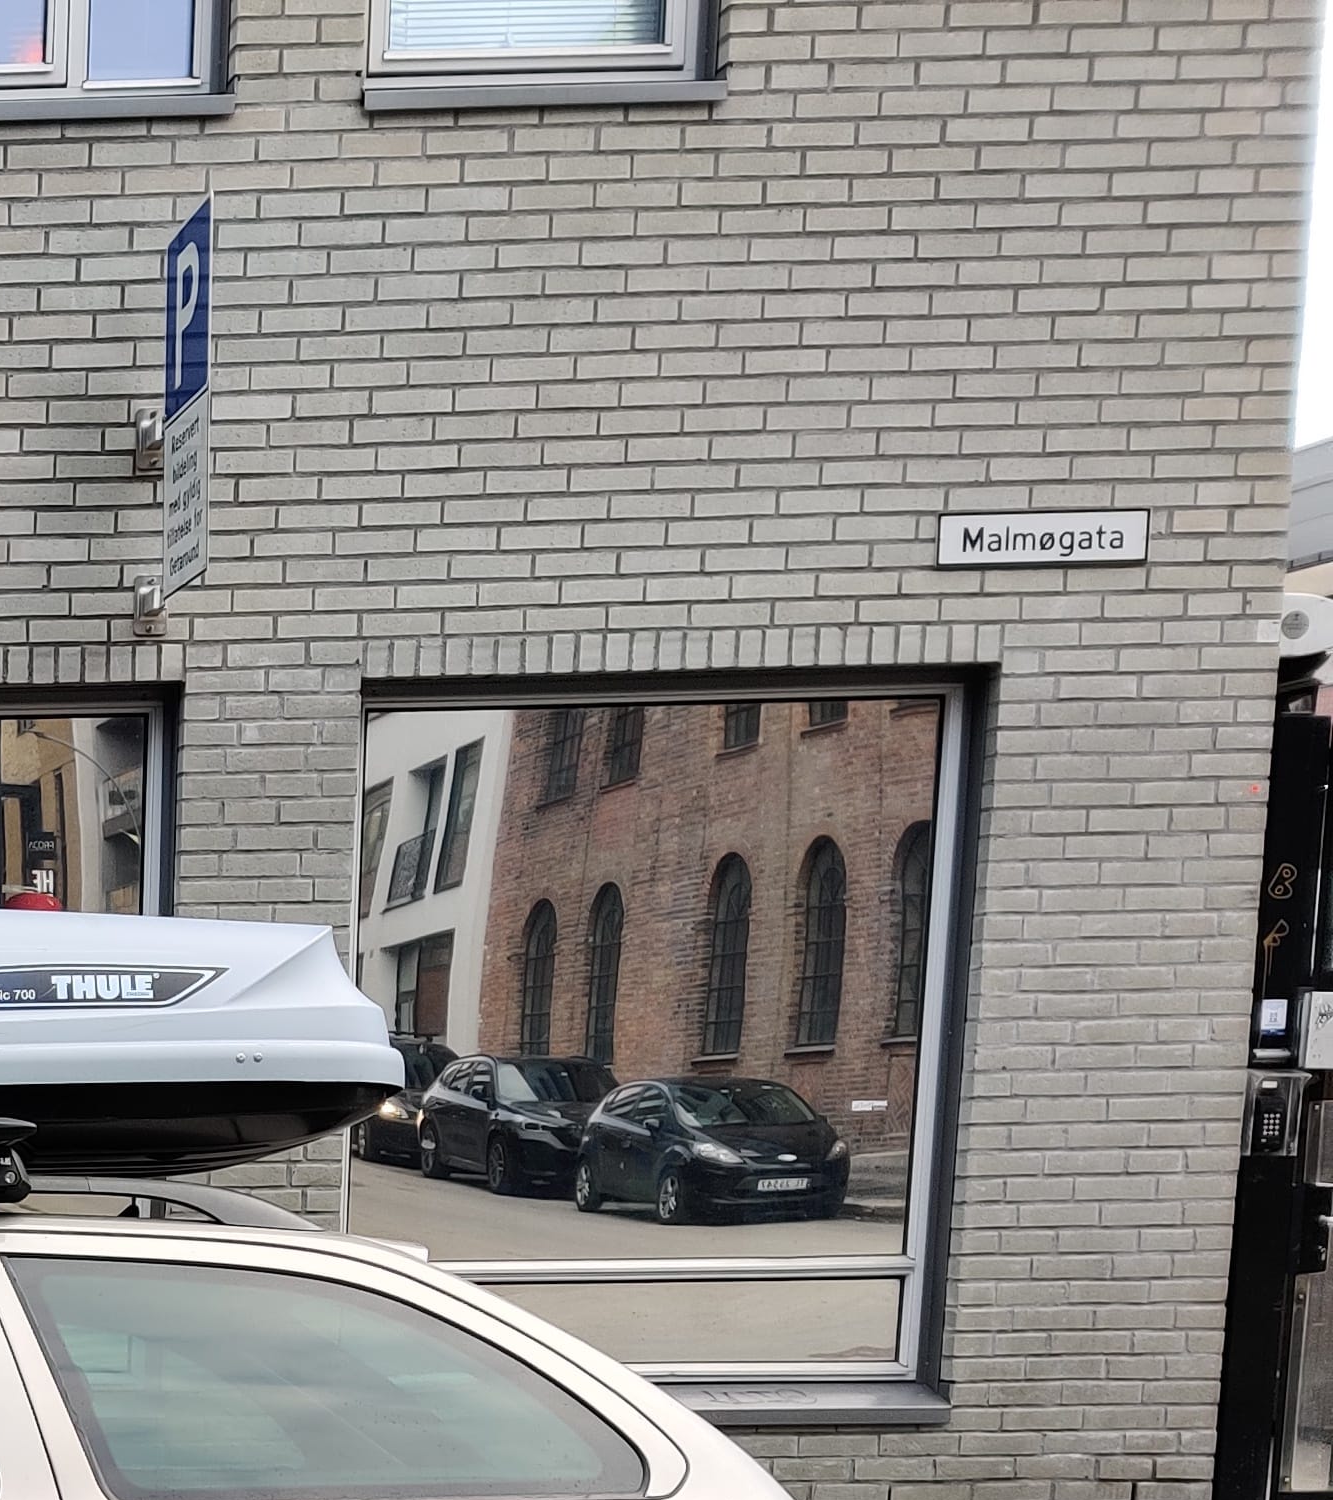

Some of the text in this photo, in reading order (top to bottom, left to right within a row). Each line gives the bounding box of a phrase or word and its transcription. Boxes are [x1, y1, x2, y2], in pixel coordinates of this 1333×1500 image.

[175, 241, 199, 390] P
[962, 525, 1125, 557] Malmøgata
[13, 989, 36, 1000] 700
[51, 975, 153, 999] THULE
